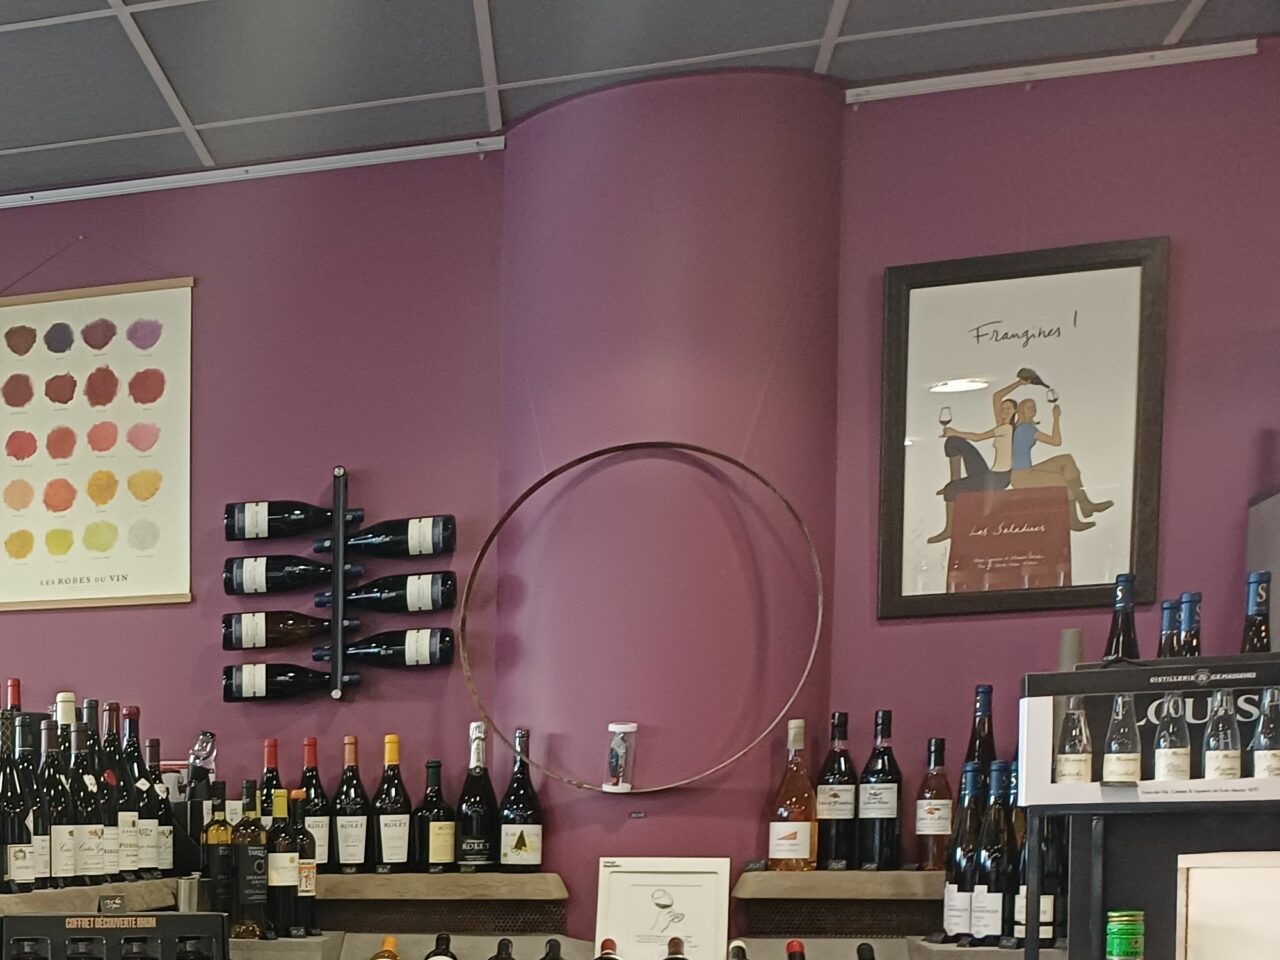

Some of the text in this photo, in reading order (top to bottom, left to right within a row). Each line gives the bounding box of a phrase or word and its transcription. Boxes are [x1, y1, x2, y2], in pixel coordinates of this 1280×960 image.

[968, 320, 1061, 348] Frangines
[57, 576, 91, 585] ROBES
[109, 574, 128, 582] VIN
[65, 917, 95, 928] COFFRET
[95, 915, 136, 928] DÉCOUVERTE
